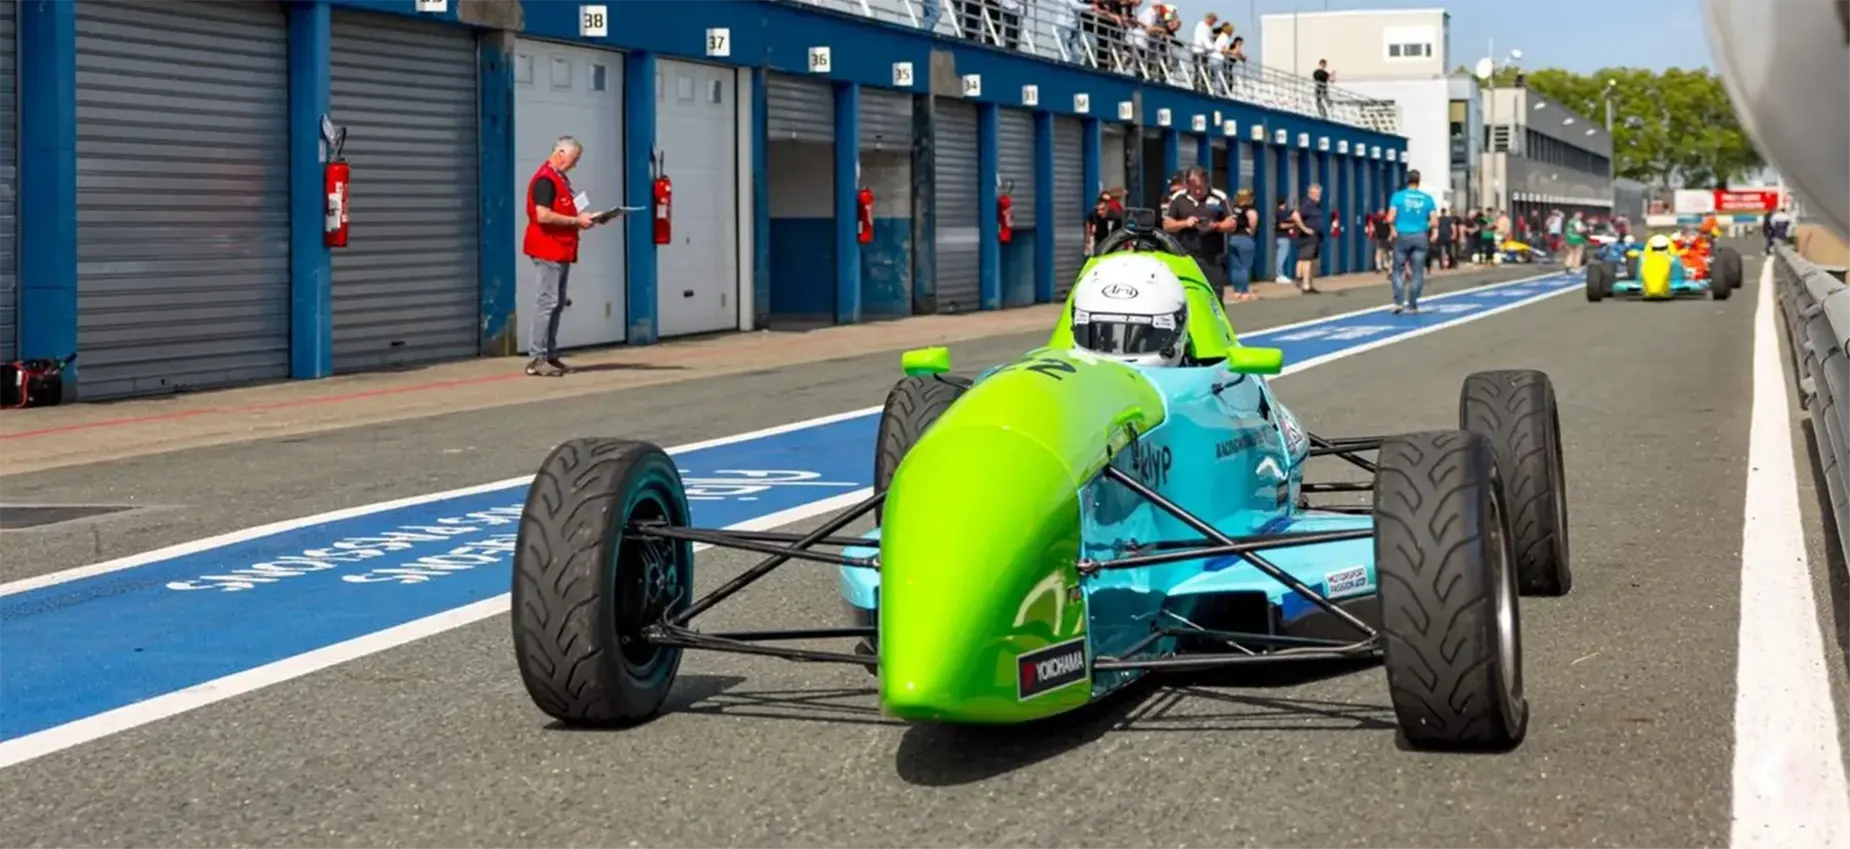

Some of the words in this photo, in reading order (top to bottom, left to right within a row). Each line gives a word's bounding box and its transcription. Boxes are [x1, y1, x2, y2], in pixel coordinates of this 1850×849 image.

[584, 13, 604, 29] 38
[708, 35, 725, 50] 37
[811, 53, 828, 67] 36
[894, 68, 910, 81] 35
[965, 79, 978, 91] 34
[1036, 650, 1084, 682] YOKOHAMA
